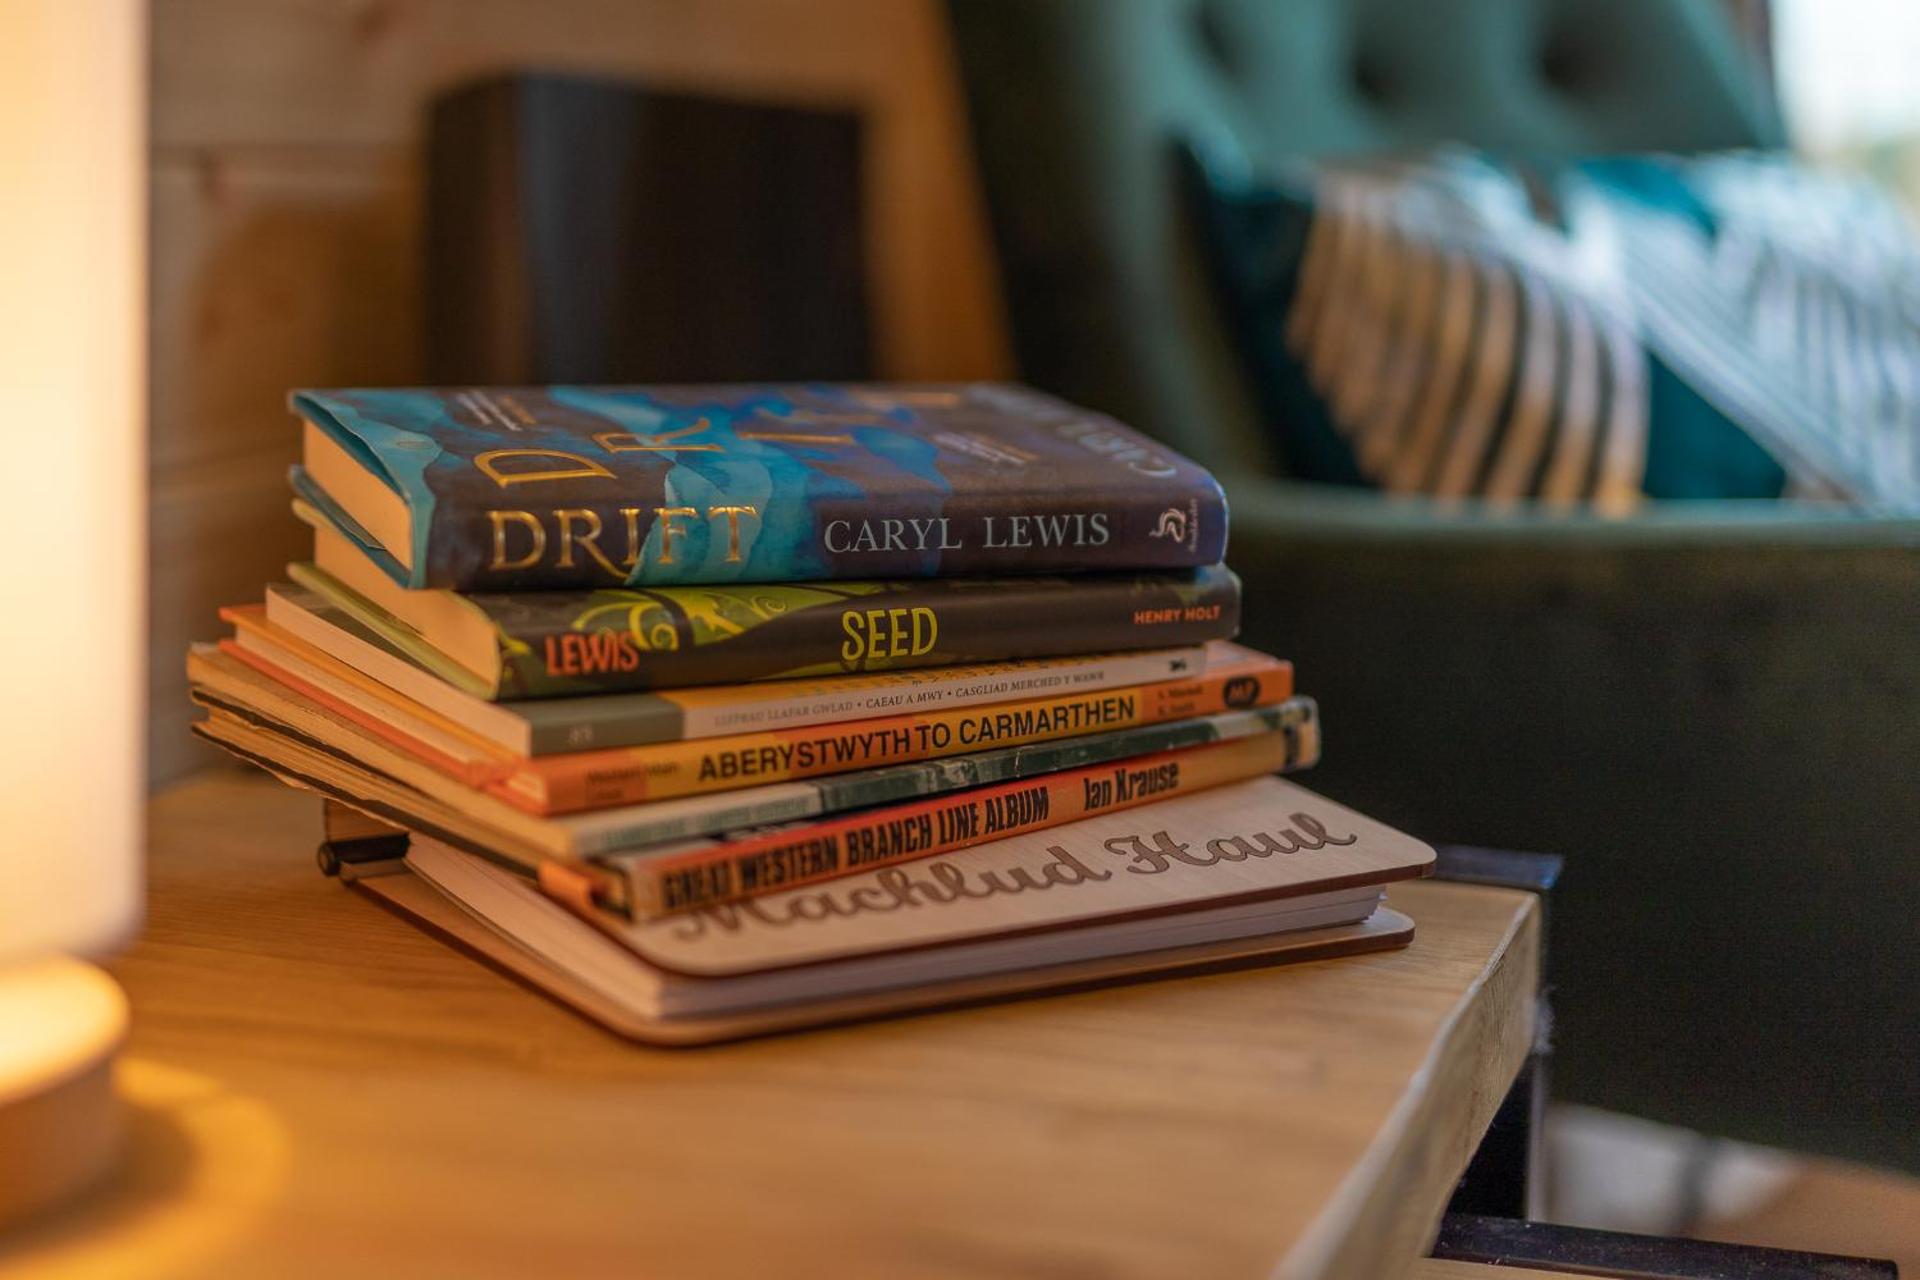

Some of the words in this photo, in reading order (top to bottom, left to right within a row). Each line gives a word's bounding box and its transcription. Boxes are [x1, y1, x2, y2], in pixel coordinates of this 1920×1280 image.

[487, 505, 758, 578] DRIFT
[823, 517, 963, 553] CARYL
[982, 513, 1110, 549] LEWIS
[841, 607, 938, 661] SEED
[1134, 609, 1181, 625] HENRY
[1185, 605, 1221, 621] HOLT
[545, 631, 640, 677] LEWIS
[866, 695, 904, 710] CAEAU
[906, 694, 914, 706] A
[916, 690, 944, 703] MWY
[955, 682, 1009, 698] CASGLIAD
[1010, 676, 1062, 692] MERCHED
[1063, 674, 1070, 685] Y
[767, 706, 810, 722] LLAFAR
[812, 701, 854, 716] GWLAD
[697, 727, 911, 782] ABERYSTWYTH
[915, 722, 951, 751] TO
[958, 695, 1135, 745] CARMARTHEN
[1083, 776, 1112, 811] Ian
[1115, 762, 1180, 802] Krause
[662, 860, 732, 908] GREAT
[739, 835, 839, 891] WESTERN
[845, 812, 933, 865] BRANCH
[937, 802, 980, 846] LINE
[984, 785, 1049, 835] ALBUM
[1103, 811, 1357, 875] Haul
